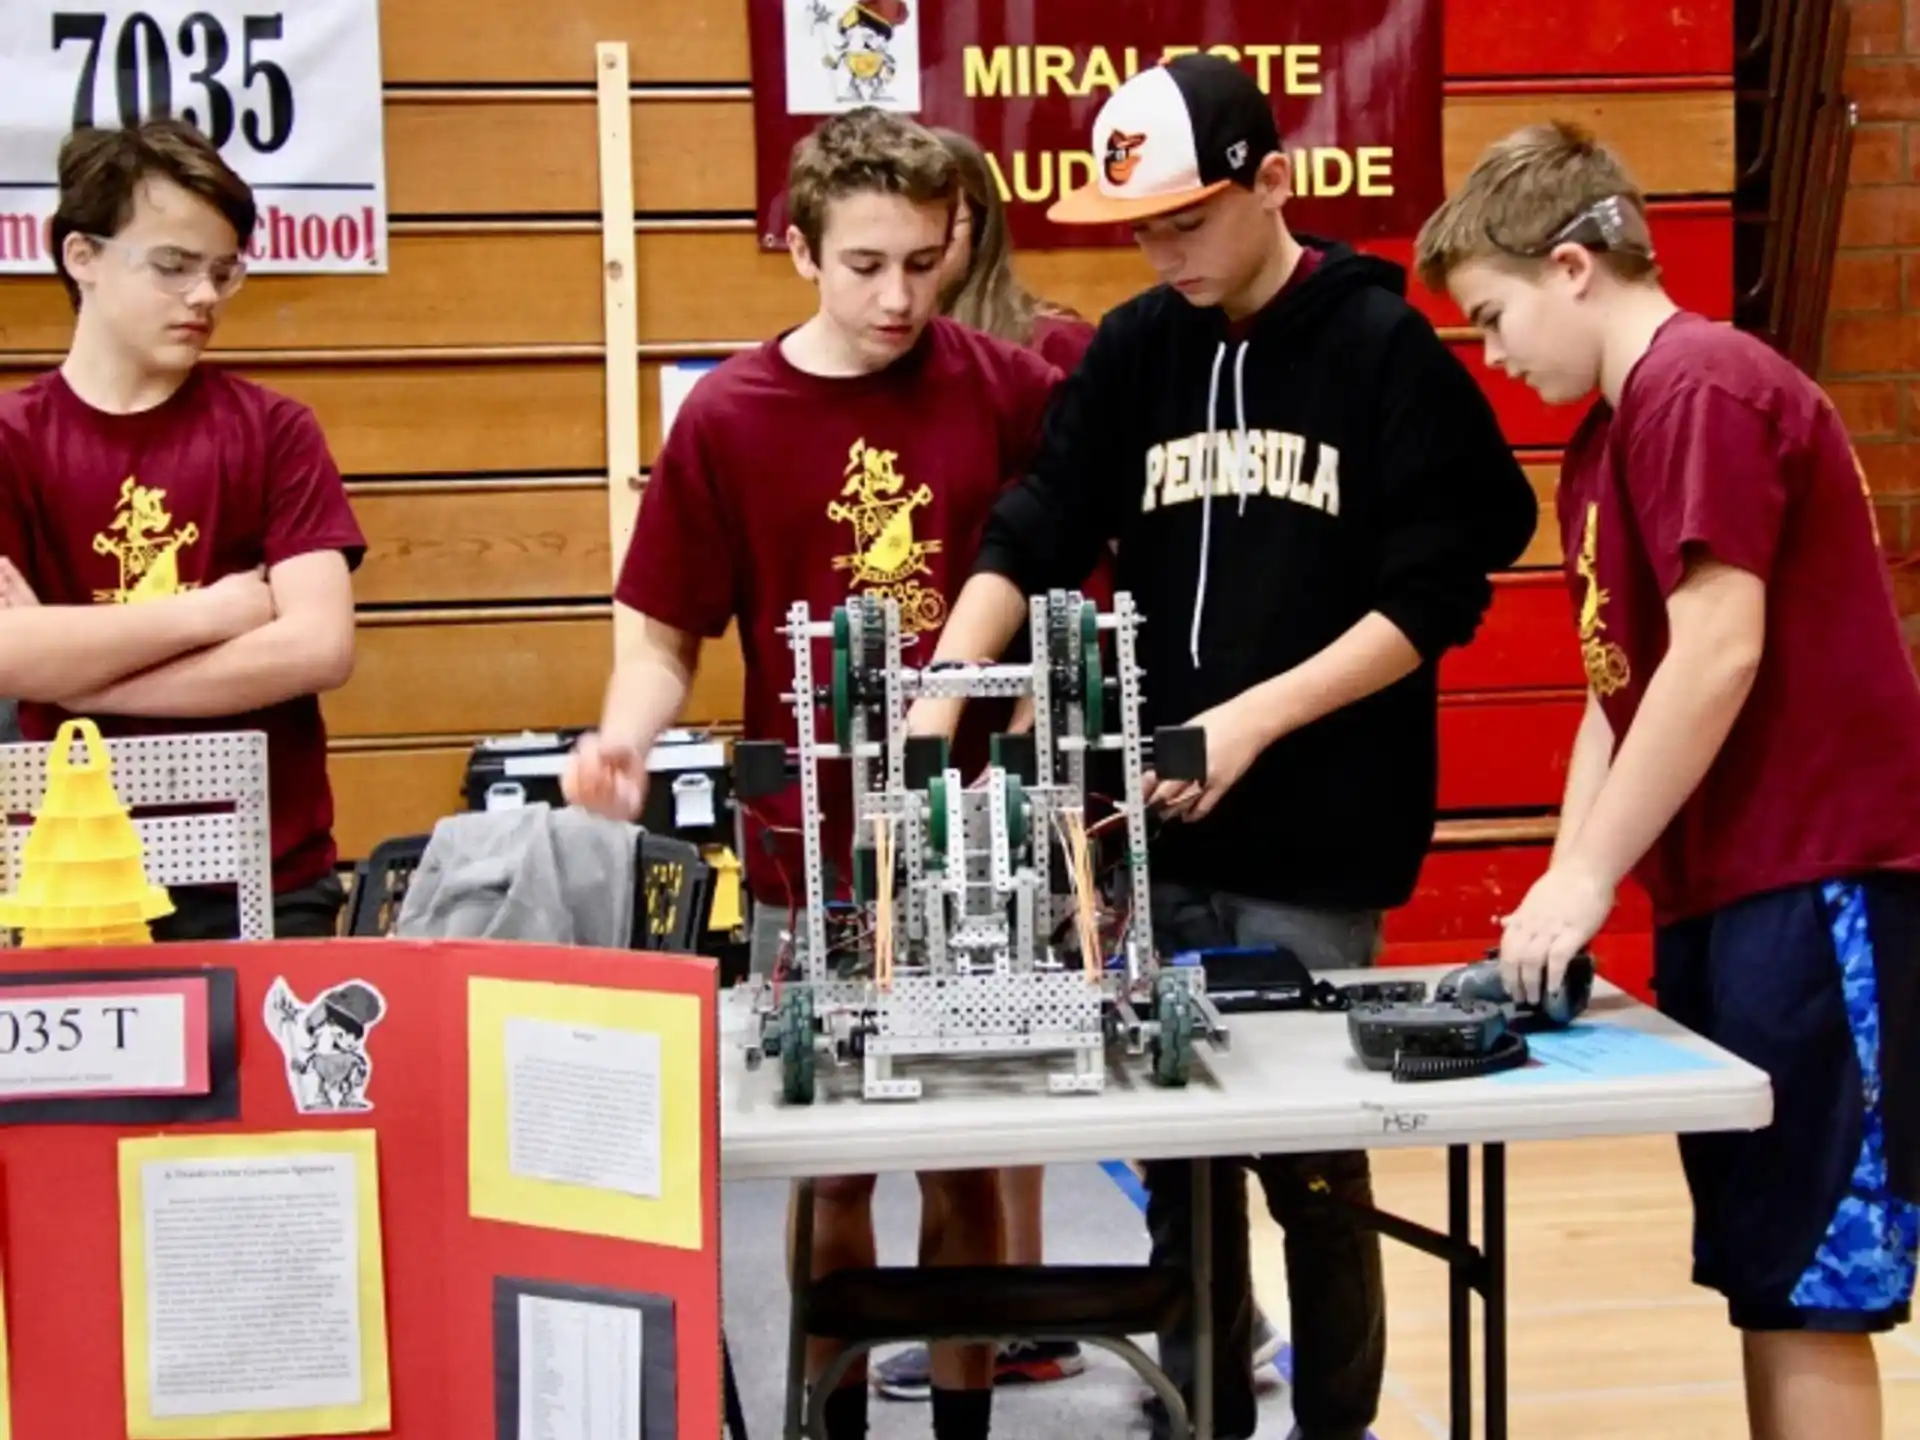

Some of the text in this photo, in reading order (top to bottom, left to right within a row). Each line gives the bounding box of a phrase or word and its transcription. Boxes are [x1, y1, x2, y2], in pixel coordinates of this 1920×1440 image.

[52, 11, 295, 154] 7035
[1292, 147, 1395, 197] IDE
[249, 206, 374, 261] chool
[101, 1007, 139, 1050] T
